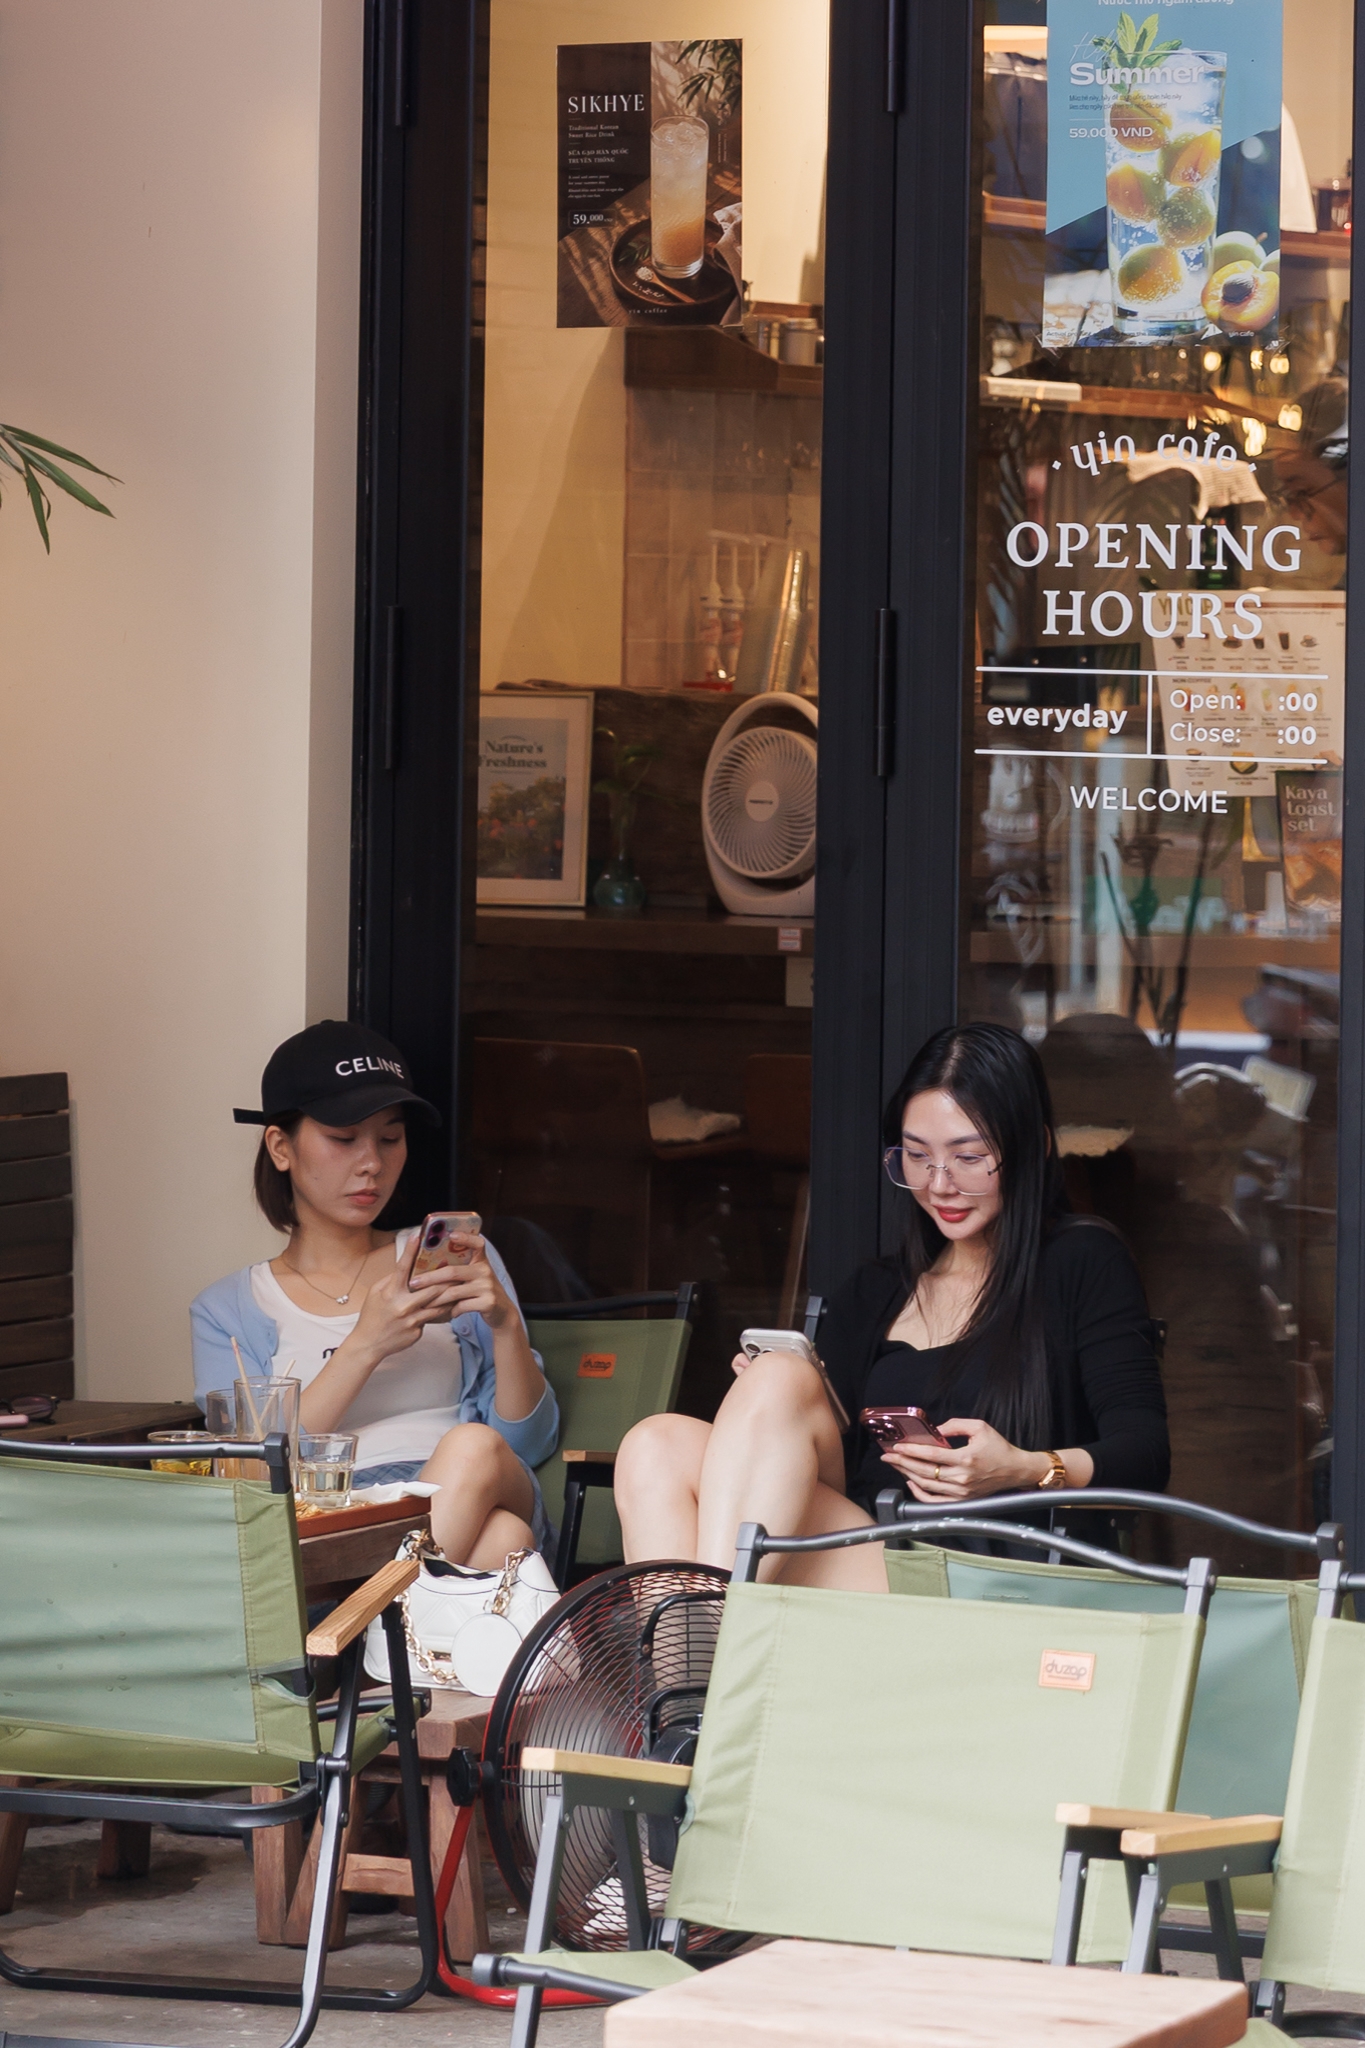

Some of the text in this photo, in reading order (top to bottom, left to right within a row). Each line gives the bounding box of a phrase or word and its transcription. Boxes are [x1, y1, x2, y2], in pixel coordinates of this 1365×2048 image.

[1070, 62, 1205, 86] Summer
[568, 94, 645, 113] SIKHYE
[1069, 127, 1153, 138] 59.000 VND
[1070, 431, 1238, 476] yin cafe
[1006, 521, 1301, 572] OPENING
[1042, 590, 1263, 640] HOURS
[1170, 689, 1318, 713] Open: :00
[987, 703, 1128, 734] everyday
[1170, 722, 1241, 743] Close:
[1277, 726, 1317, 745] :00
[485, 741, 544, 753] Nature's
[1070, 785, 1228, 814] WELCOME
[335, 1056, 404, 1079] CELINE
